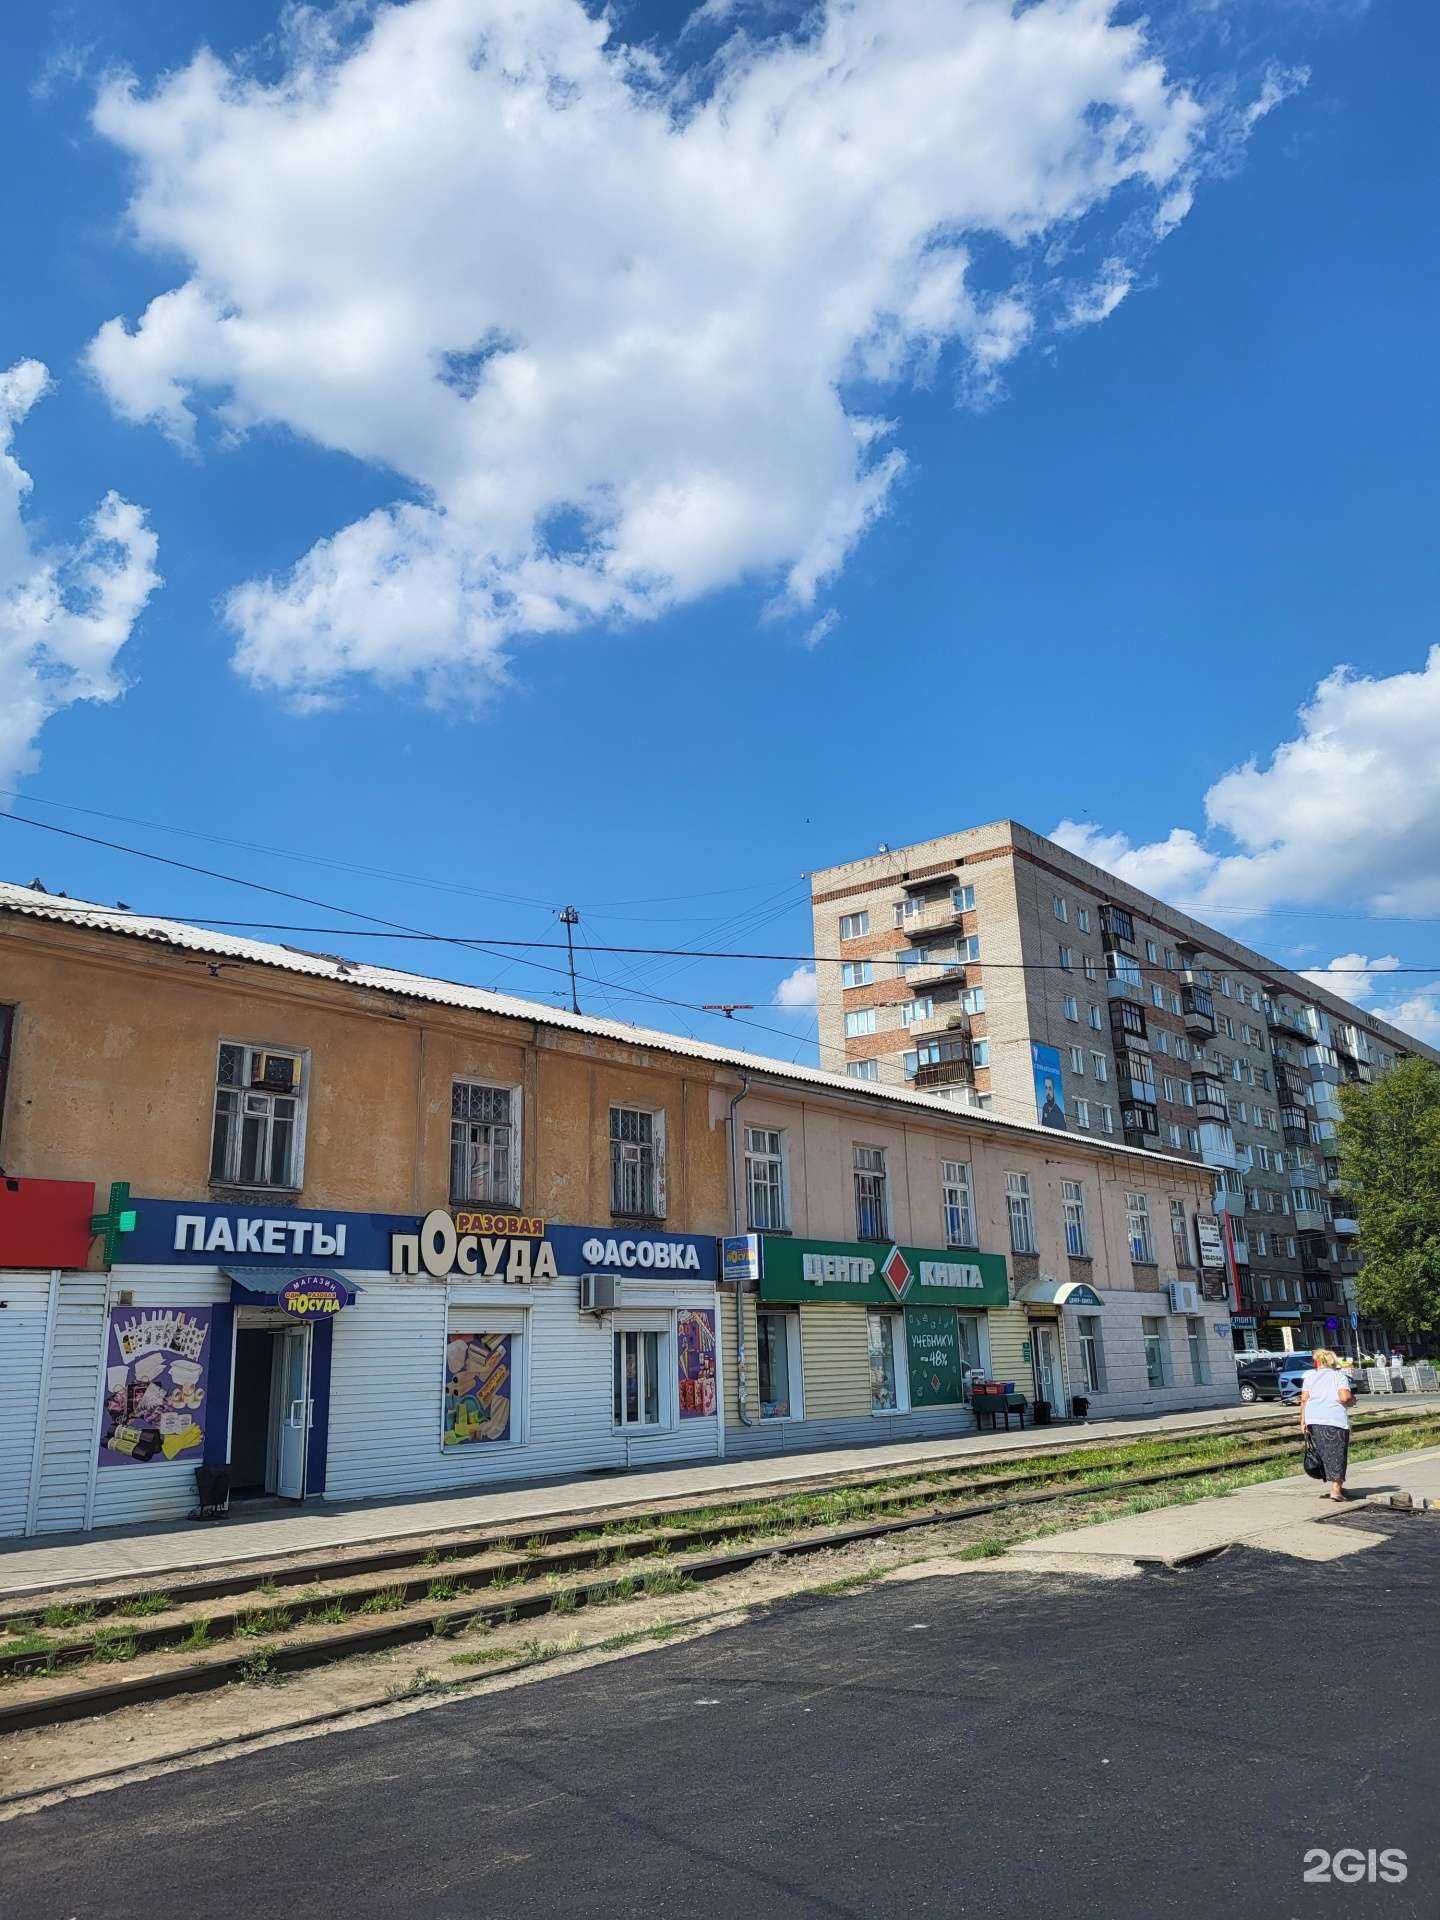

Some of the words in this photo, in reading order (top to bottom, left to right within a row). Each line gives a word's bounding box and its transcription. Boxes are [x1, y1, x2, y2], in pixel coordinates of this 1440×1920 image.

[173, 1214, 348, 1256] ПАКЕТЫ
[456, 1212, 545, 1236] РАЗОВАЯ
[391, 1208, 559, 1284] ПОСУДА
[582, 1237, 701, 1270] ФАСОВКА
[802, 1253, 876, 1287] ЦЕНТР
[919, 1261, 985, 1289] КНИГА
[293, 1276, 336, 1291] МАГАЗИН
[287, 1294, 341, 1313] ПОСУДА
[911, 1334, 955, 1348] УЧЕБНИКИ
[920, 1350, 948, 1367] -48%
